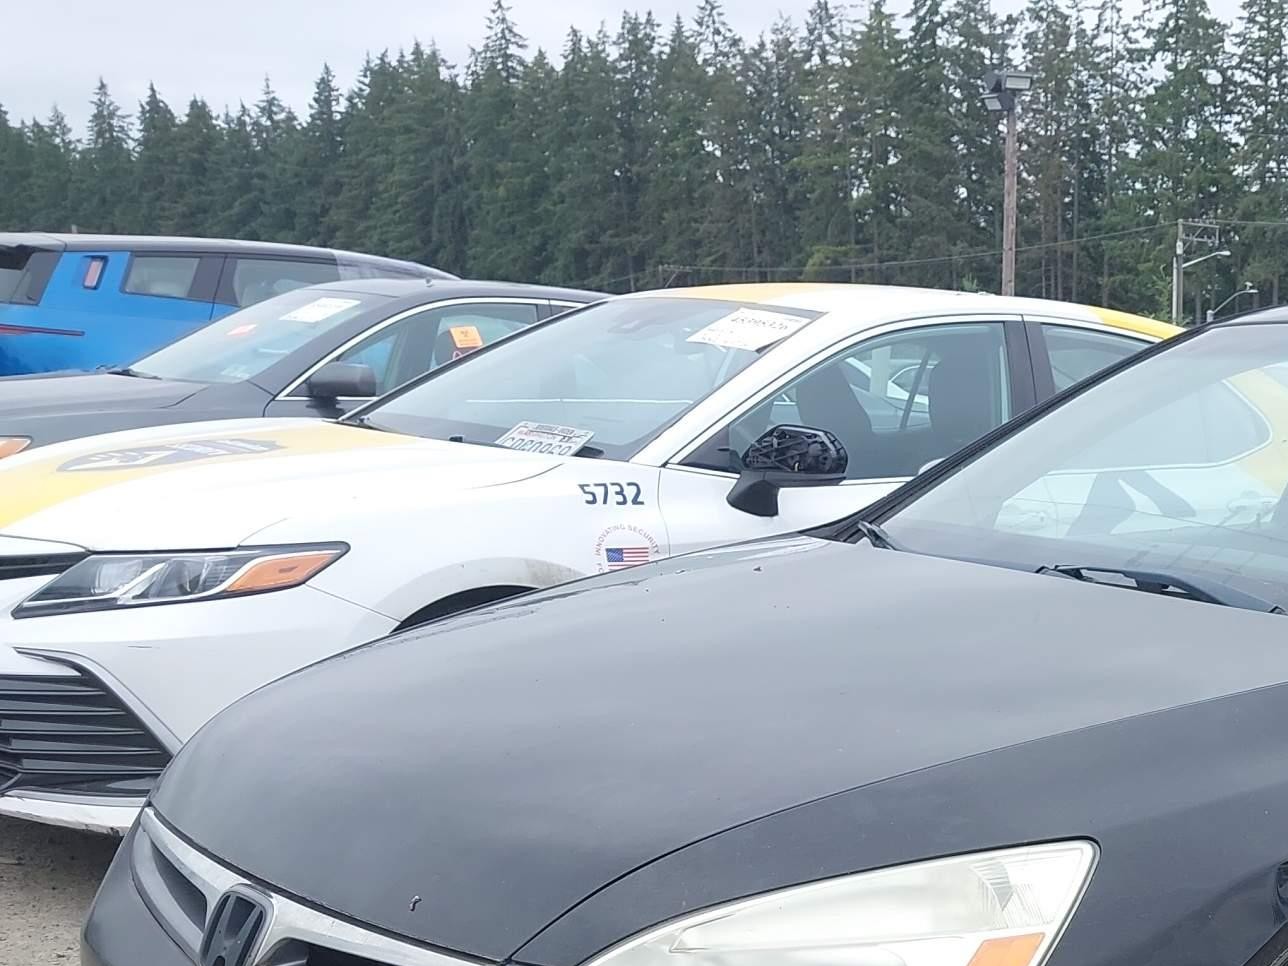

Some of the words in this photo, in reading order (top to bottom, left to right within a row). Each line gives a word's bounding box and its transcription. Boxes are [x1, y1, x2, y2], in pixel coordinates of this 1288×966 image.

[578, 482, 645, 506] 5732
[595, 523, 626, 557] INNOVATING
[627, 524, 661, 554] SECURITY
